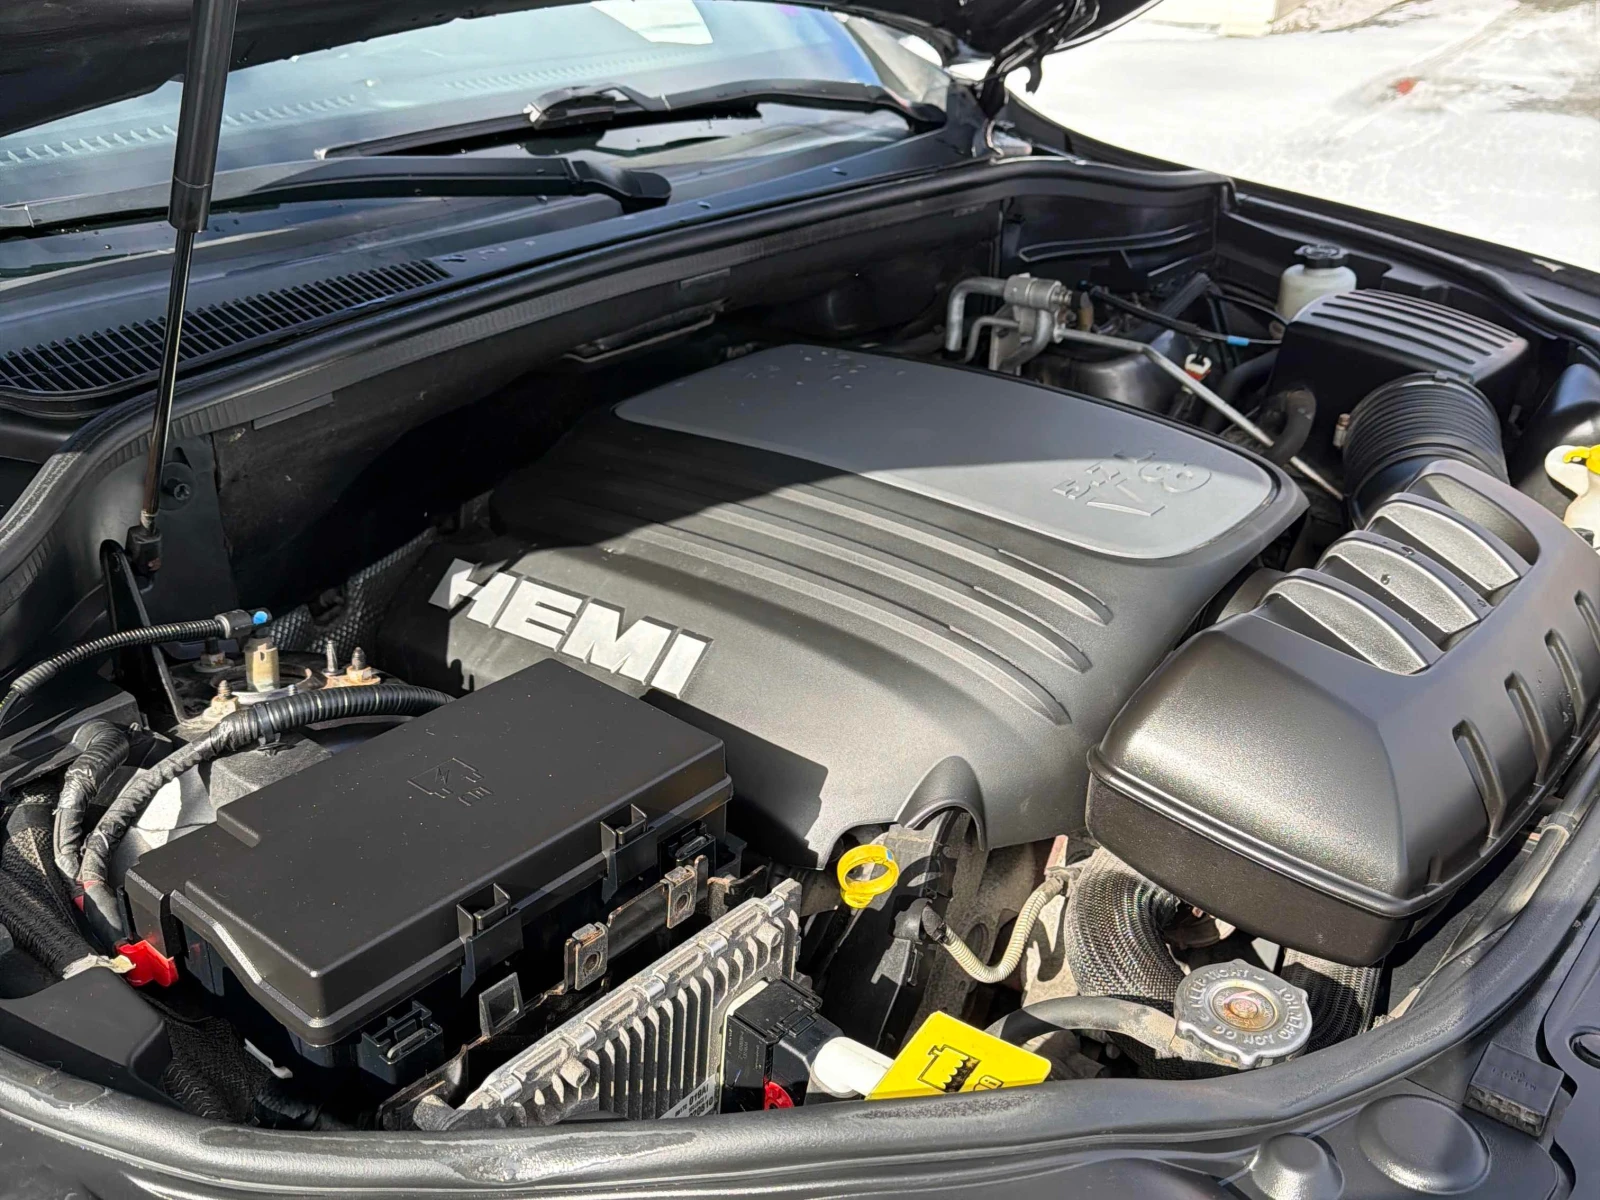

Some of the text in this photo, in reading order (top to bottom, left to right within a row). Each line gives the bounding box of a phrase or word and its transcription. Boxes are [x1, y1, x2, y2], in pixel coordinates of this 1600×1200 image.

[1085, 461, 1213, 517] V8
[427, 557, 715, 699] HEMI
[1188, 978, 1207, 1008] KEEP
[1212, 1025, 1238, 1040] DO
[1243, 1034, 1275, 1046] NOT
[1277, 1013, 1304, 1040] OPEN
